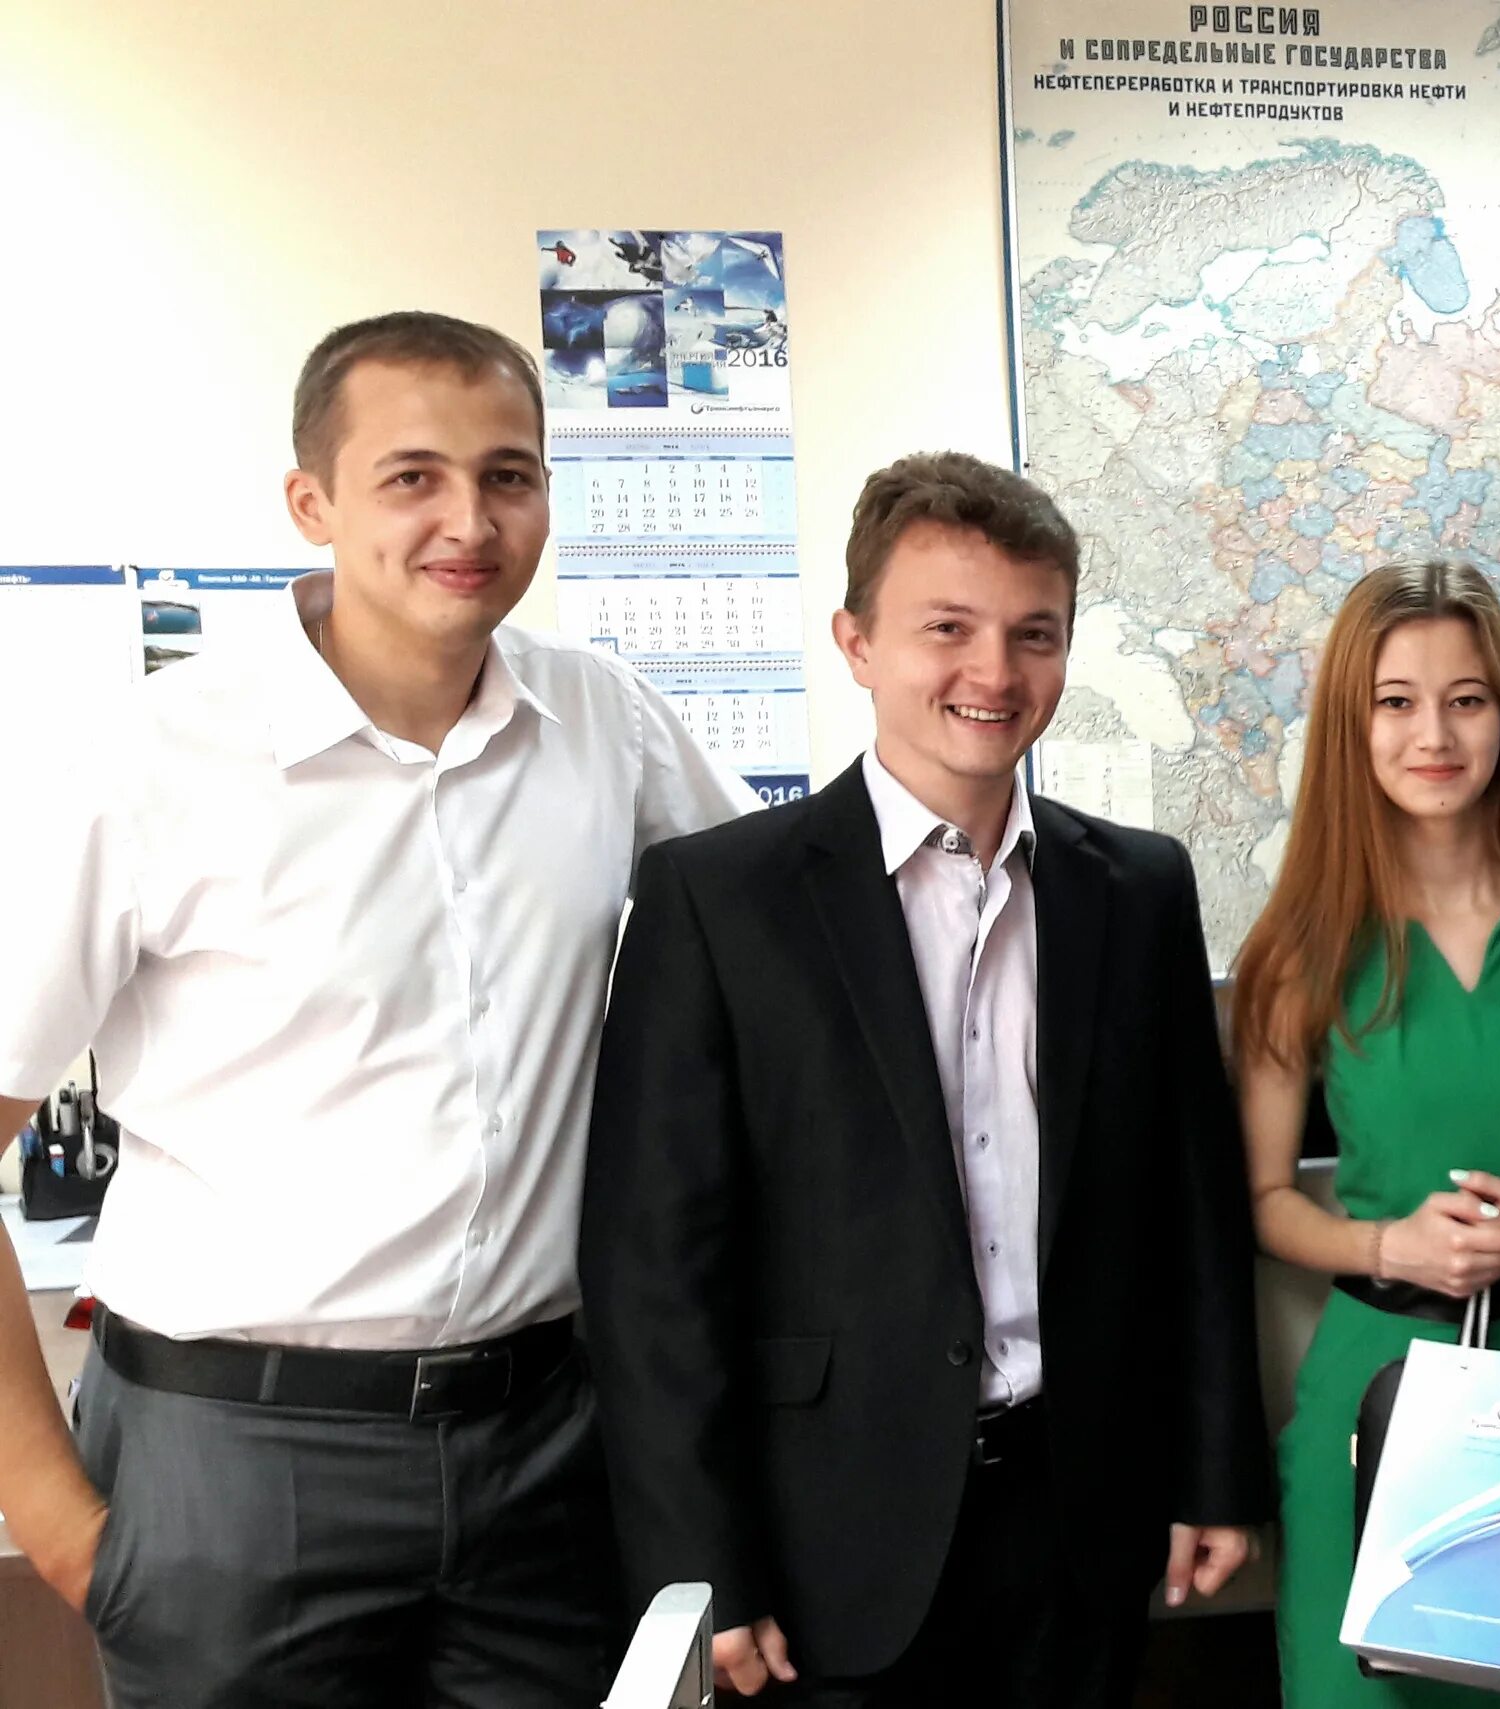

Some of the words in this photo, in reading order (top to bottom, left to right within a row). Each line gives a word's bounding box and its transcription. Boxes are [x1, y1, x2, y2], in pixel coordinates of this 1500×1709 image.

[1190, 5, 1320, 36] РОССИЯ
[1060, 39, 1075, 60] И
[1086, 39, 1276, 65] СОПРЕДЕЛЬНЫЕ
[1286, 44, 1447, 70] ГОСУДАРСТВА
[1034, 74, 1217, 93] НЕФТЕПЕРЕРАБОТКА
[1222, 79, 1234, 93] И
[1239, 79, 1404, 99] ТРАНСПОРТИРОВКА
[1409, 84, 1467, 100] НЕФТИ
[1168, 102, 1180, 117] И
[1186, 103, 1344, 121] НЕФТЕПРОДУКТОВ
[728, 349, 788, 368] 2016
